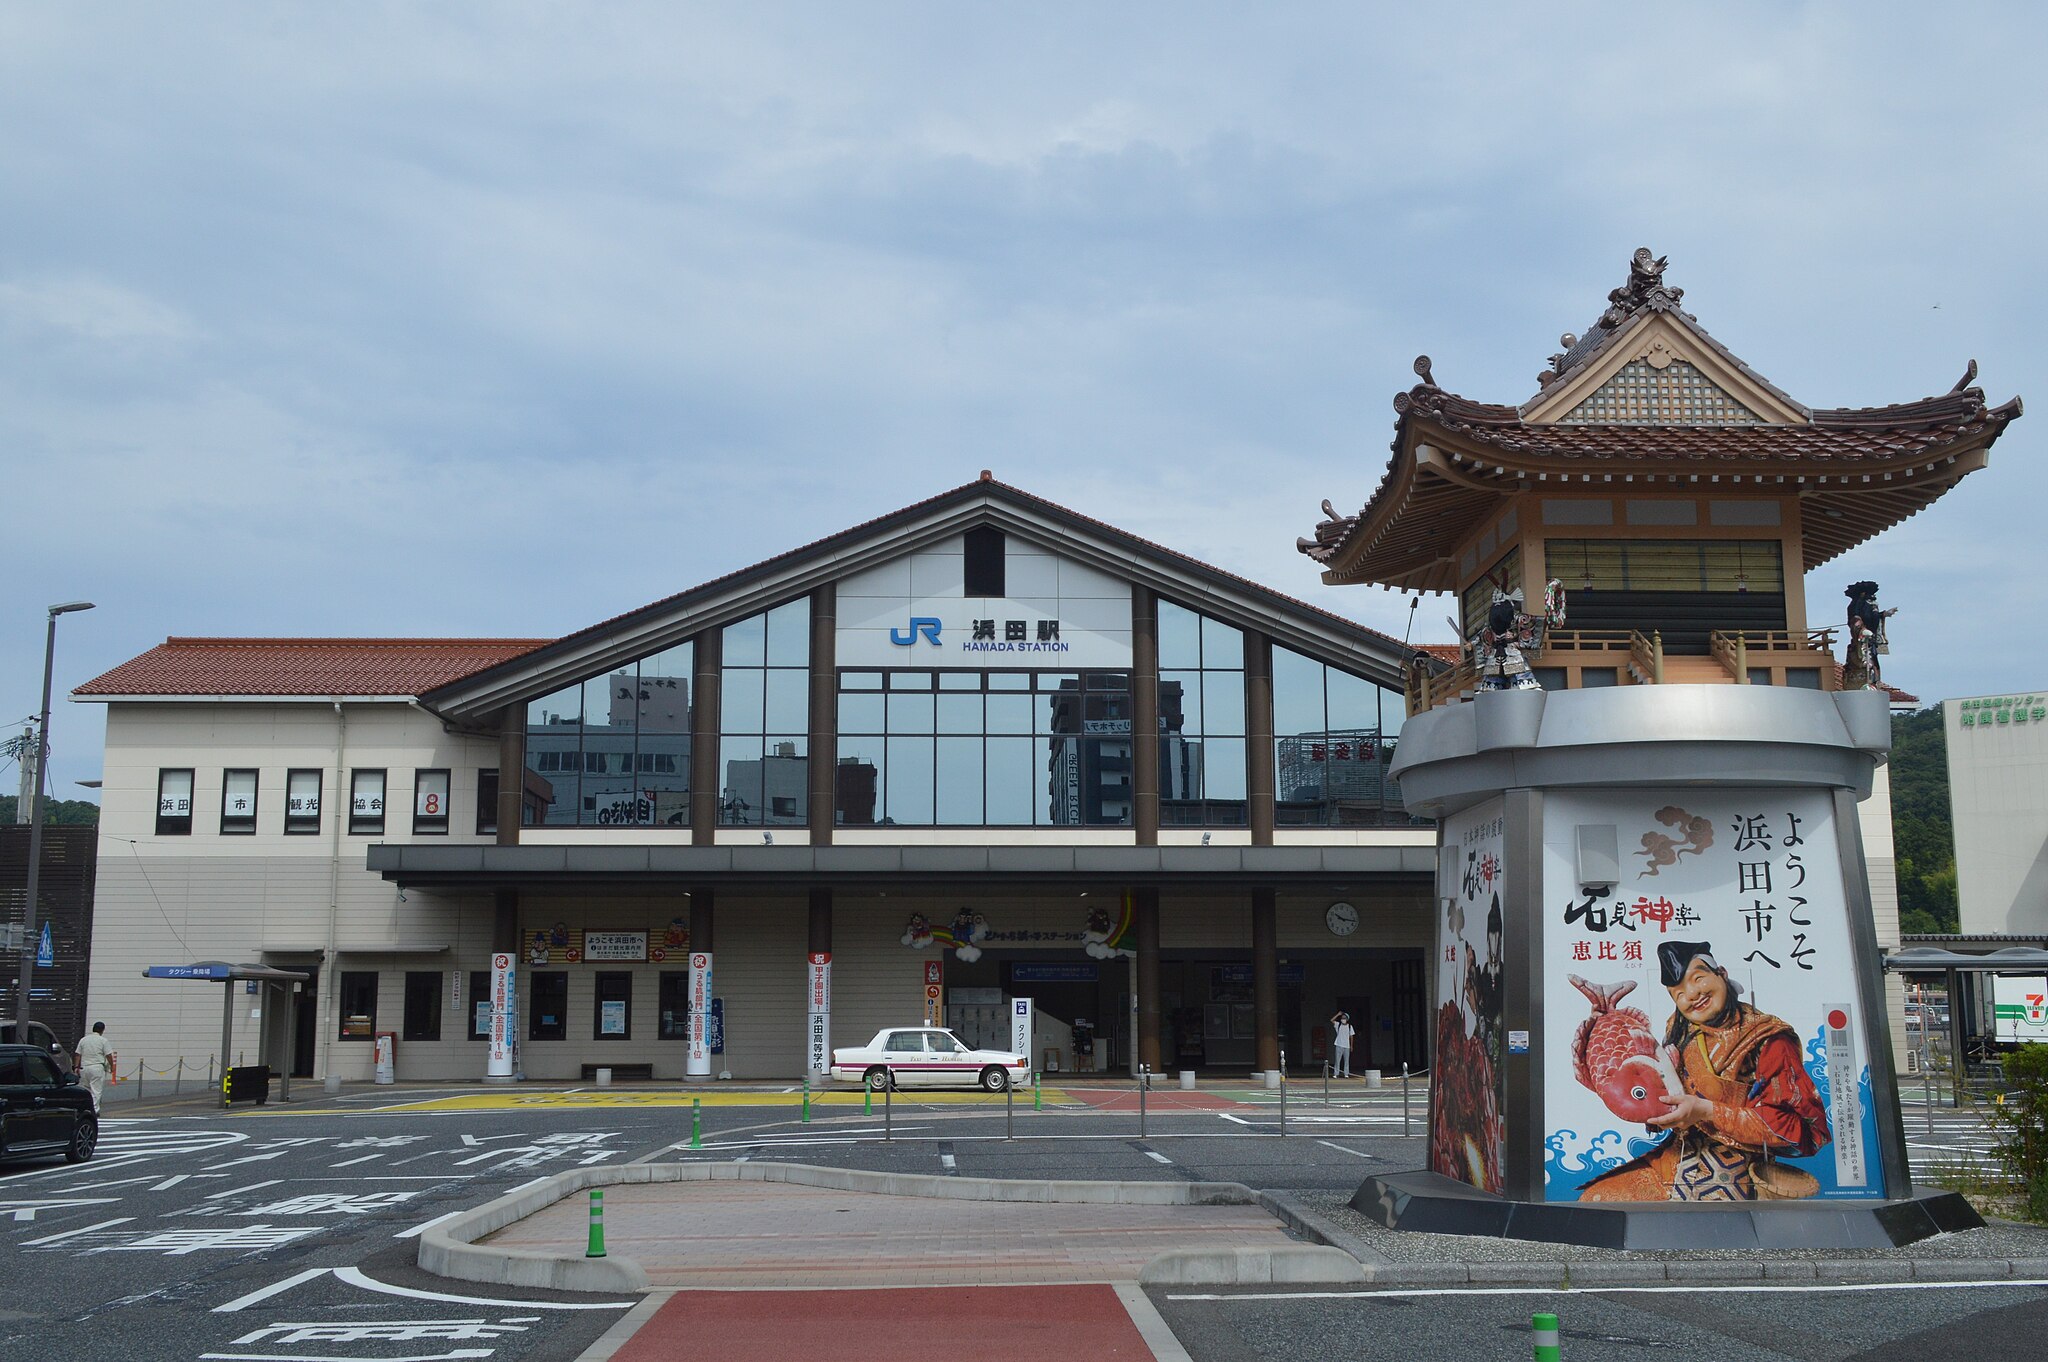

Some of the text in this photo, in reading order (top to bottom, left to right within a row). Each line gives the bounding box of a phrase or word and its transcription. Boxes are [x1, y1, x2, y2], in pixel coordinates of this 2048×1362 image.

[890, 617, 943, 646] JR
[972, 619, 1060, 641] 浜田駅
[963, 642, 1069, 652] HAMADA STATION
[161, 798, 382, 811] 浜田 市 観光 協会
[1731, 813, 1783, 971] 浜田市へ
[1783, 811, 1815, 972] ようこそ
[1564, 885, 1702, 933] 石見神楽
[588, 936, 644, 944] ようこそ浜田市へ
[1572, 940, 1643, 961] 恵比須
[814, 954, 825, 964] 祝
